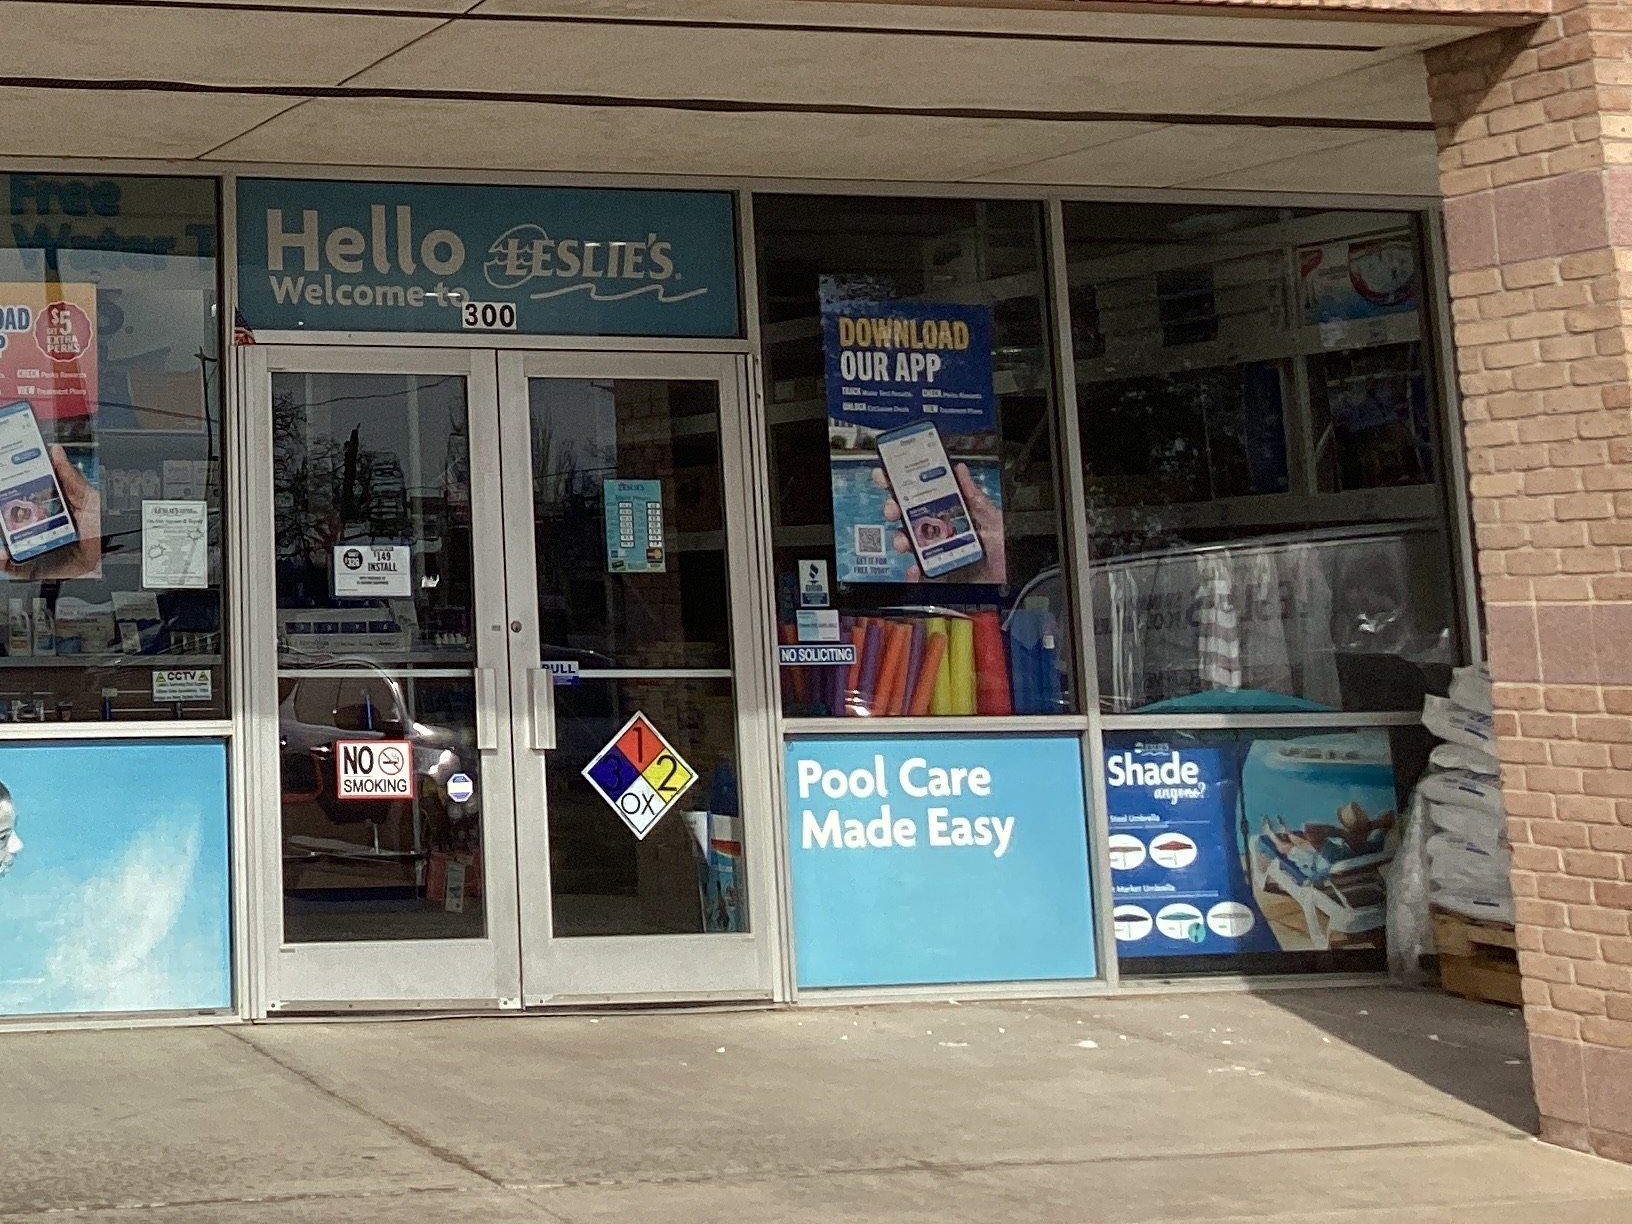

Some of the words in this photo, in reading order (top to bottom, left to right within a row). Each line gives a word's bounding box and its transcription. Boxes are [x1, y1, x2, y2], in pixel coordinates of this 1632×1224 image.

[10, 174, 121, 216] Free
[268, 204, 466, 276] Hello
[269, 274, 425, 308] Welcome
[433, 281, 469, 308] to
[464, 303, 515, 327] 300
[839, 316, 970, 351] DOWNLOAD
[840, 350, 890, 382] OUR
[894, 351, 942, 383] APP
[781, 648, 796, 662] NO
[798, 648, 853, 662] SOLICITING
[167, 671, 197, 681] CCTV
[343, 745, 374, 774] NO
[632, 726, 643, 763] 1
[343, 778, 408, 793] SMOKING
[656, 754, 678, 792] 2
[797, 754, 890, 799] Pool
[899, 757, 992, 798] Care
[1107, 750, 1200, 787] Shade
[620, 792, 656, 816] OX
[802, 804, 918, 849] Made
[927, 807, 1016, 858] Easy
